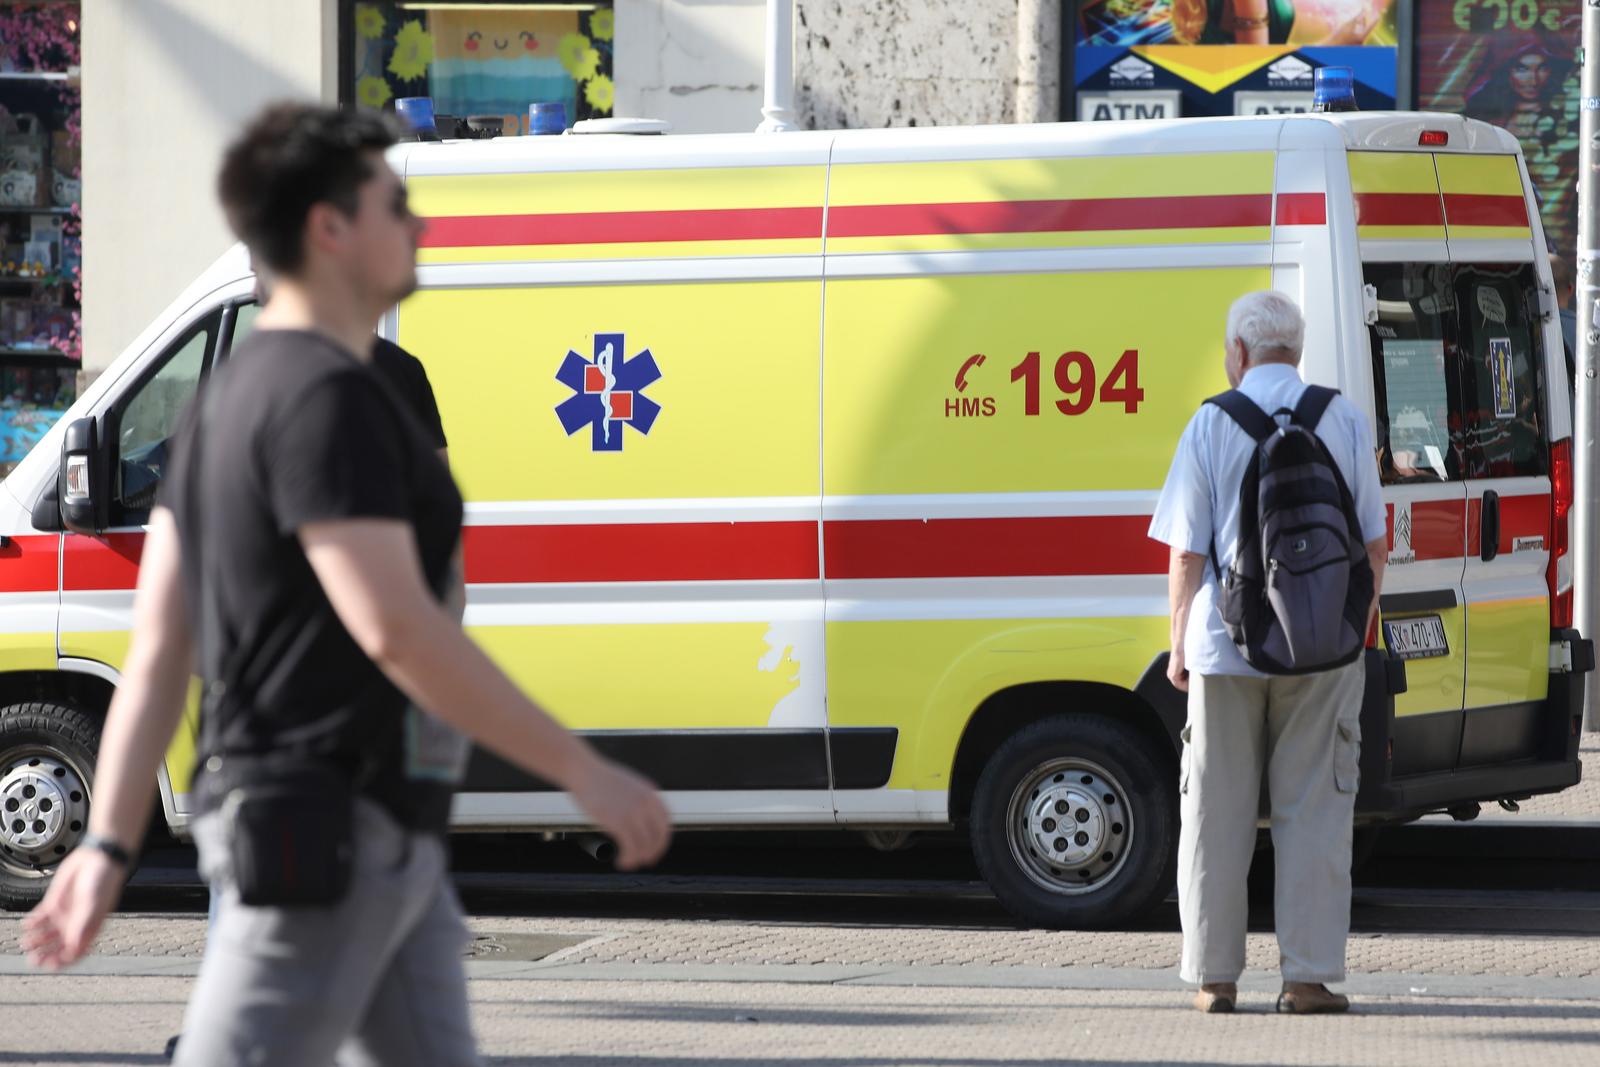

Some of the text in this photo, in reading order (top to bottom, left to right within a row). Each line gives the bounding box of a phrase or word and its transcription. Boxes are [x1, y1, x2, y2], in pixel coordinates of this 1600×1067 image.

[1093, 104, 1164, 120] ATM
[945, 349, 1144, 417] HMS 194
